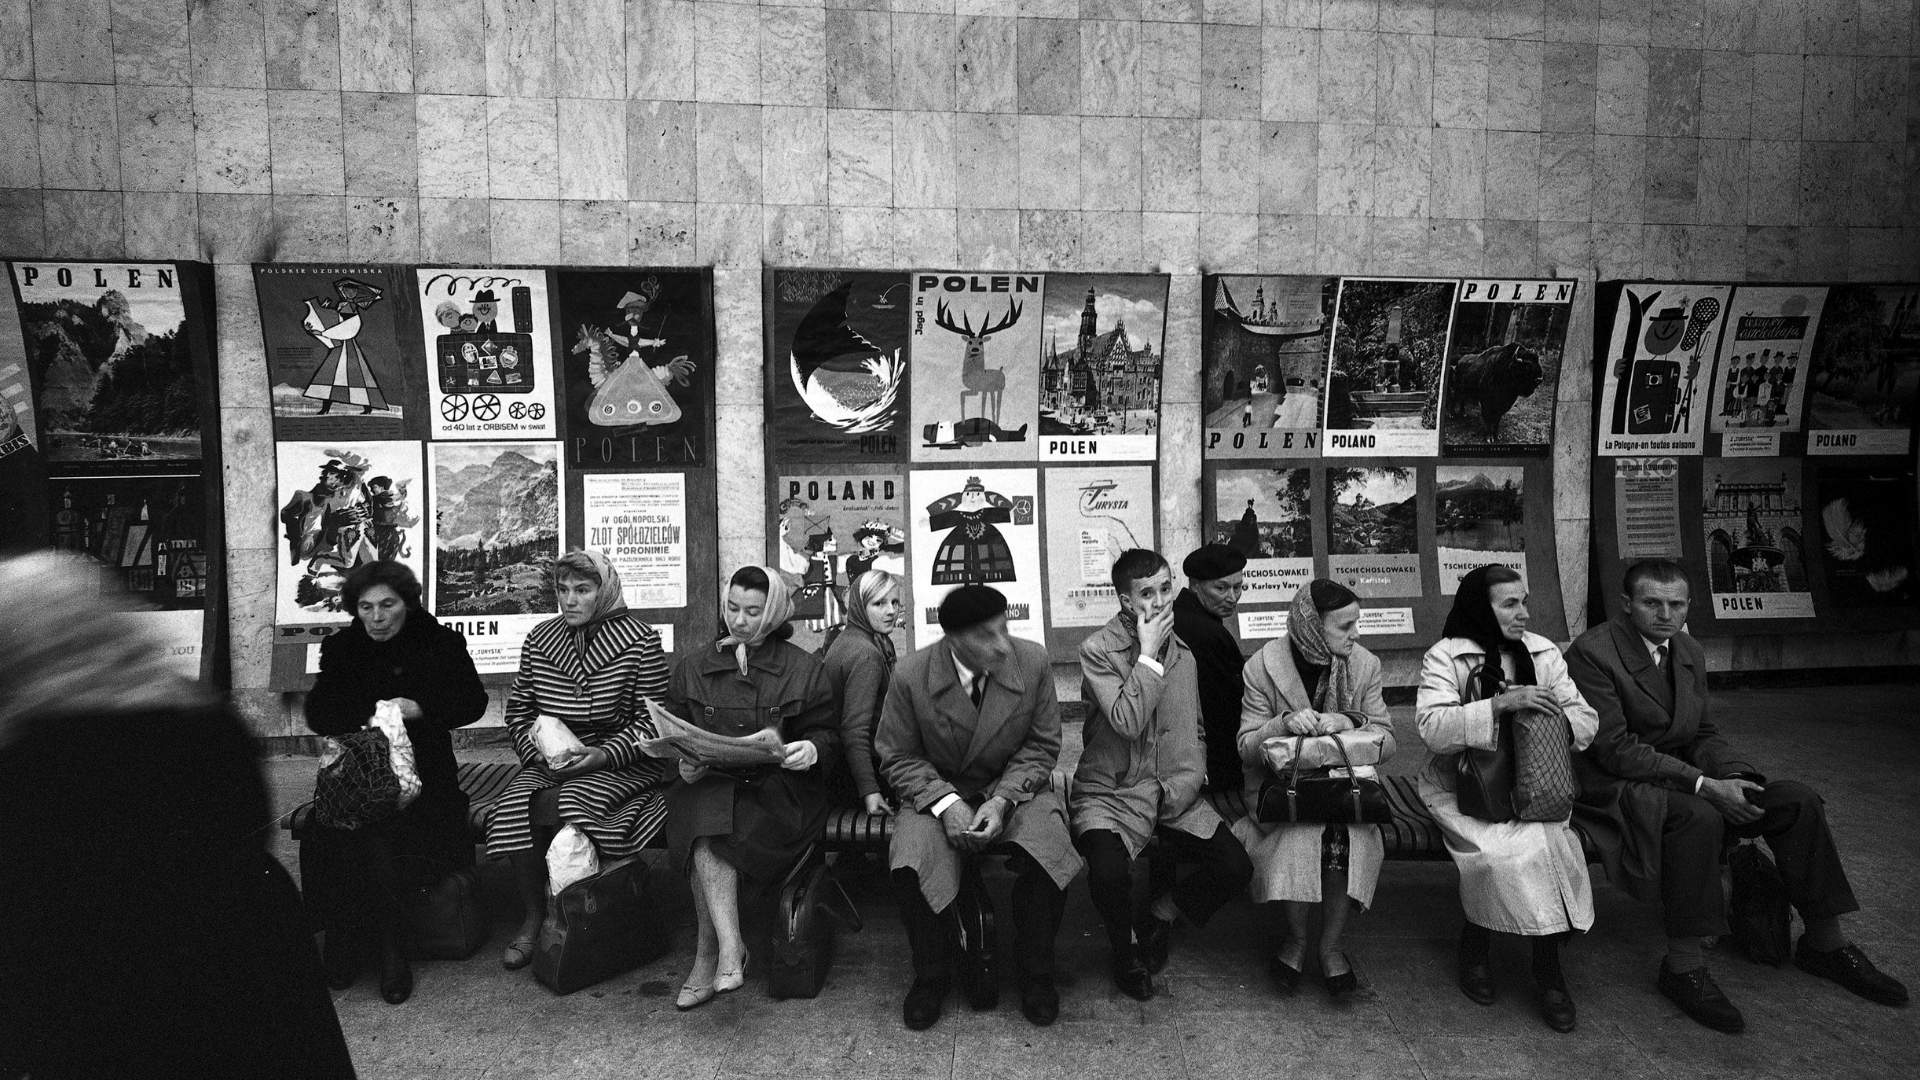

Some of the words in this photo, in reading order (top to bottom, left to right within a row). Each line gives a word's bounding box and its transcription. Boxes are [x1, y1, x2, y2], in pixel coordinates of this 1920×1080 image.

[22, 266, 173, 288] POLEN
[918, 275, 1039, 293] POLEN
[1463, 283, 1571, 301] POLEN
[915, 296, 924, 306] in
[915, 310, 925, 335] Jagd
[453, 423, 465, 431] 40
[466, 423, 476, 431] lat
[483, 423, 519, 431] ORBISEM
[0, 434, 31, 458] BIS
[860, 435, 897, 454] POLEN
[1049, 440, 1097, 455] POLEN
[1207, 432, 1318, 449] POLEN
[1331, 434, 1376, 448] POLAND
[1605, 440, 1613, 450] La
[1650, 440, 1670, 450] toutes
[1671, 440, 1696, 450] saisons
[1816, 434, 1857, 447] POLAND
[576, 436, 696, 463] POLEN
[1615, 457, 1678, 478] PKO
[789, 480, 895, 500] POLAND
[602, 516, 609, 524] IV
[613, 515, 670, 524] OGÓLNOPOLSKI
[591, 527, 613, 546] ZLOT
[617, 524, 681, 545] SPÓŁDZIELCÓW
[602, 547, 611, 555] W
[616, 546, 670, 555] PORONINIE
[1242, 568, 1309, 578] HECHOSLOWAKEI
[1335, 566, 1416, 574] TSCHECHOSLOWAKEI
[1251, 582, 1281, 590] Karlovy
[1282, 581, 1300, 590] Vary
[1722, 597, 1763, 611] POLEN
[170, 645, 195, 656] YOU
